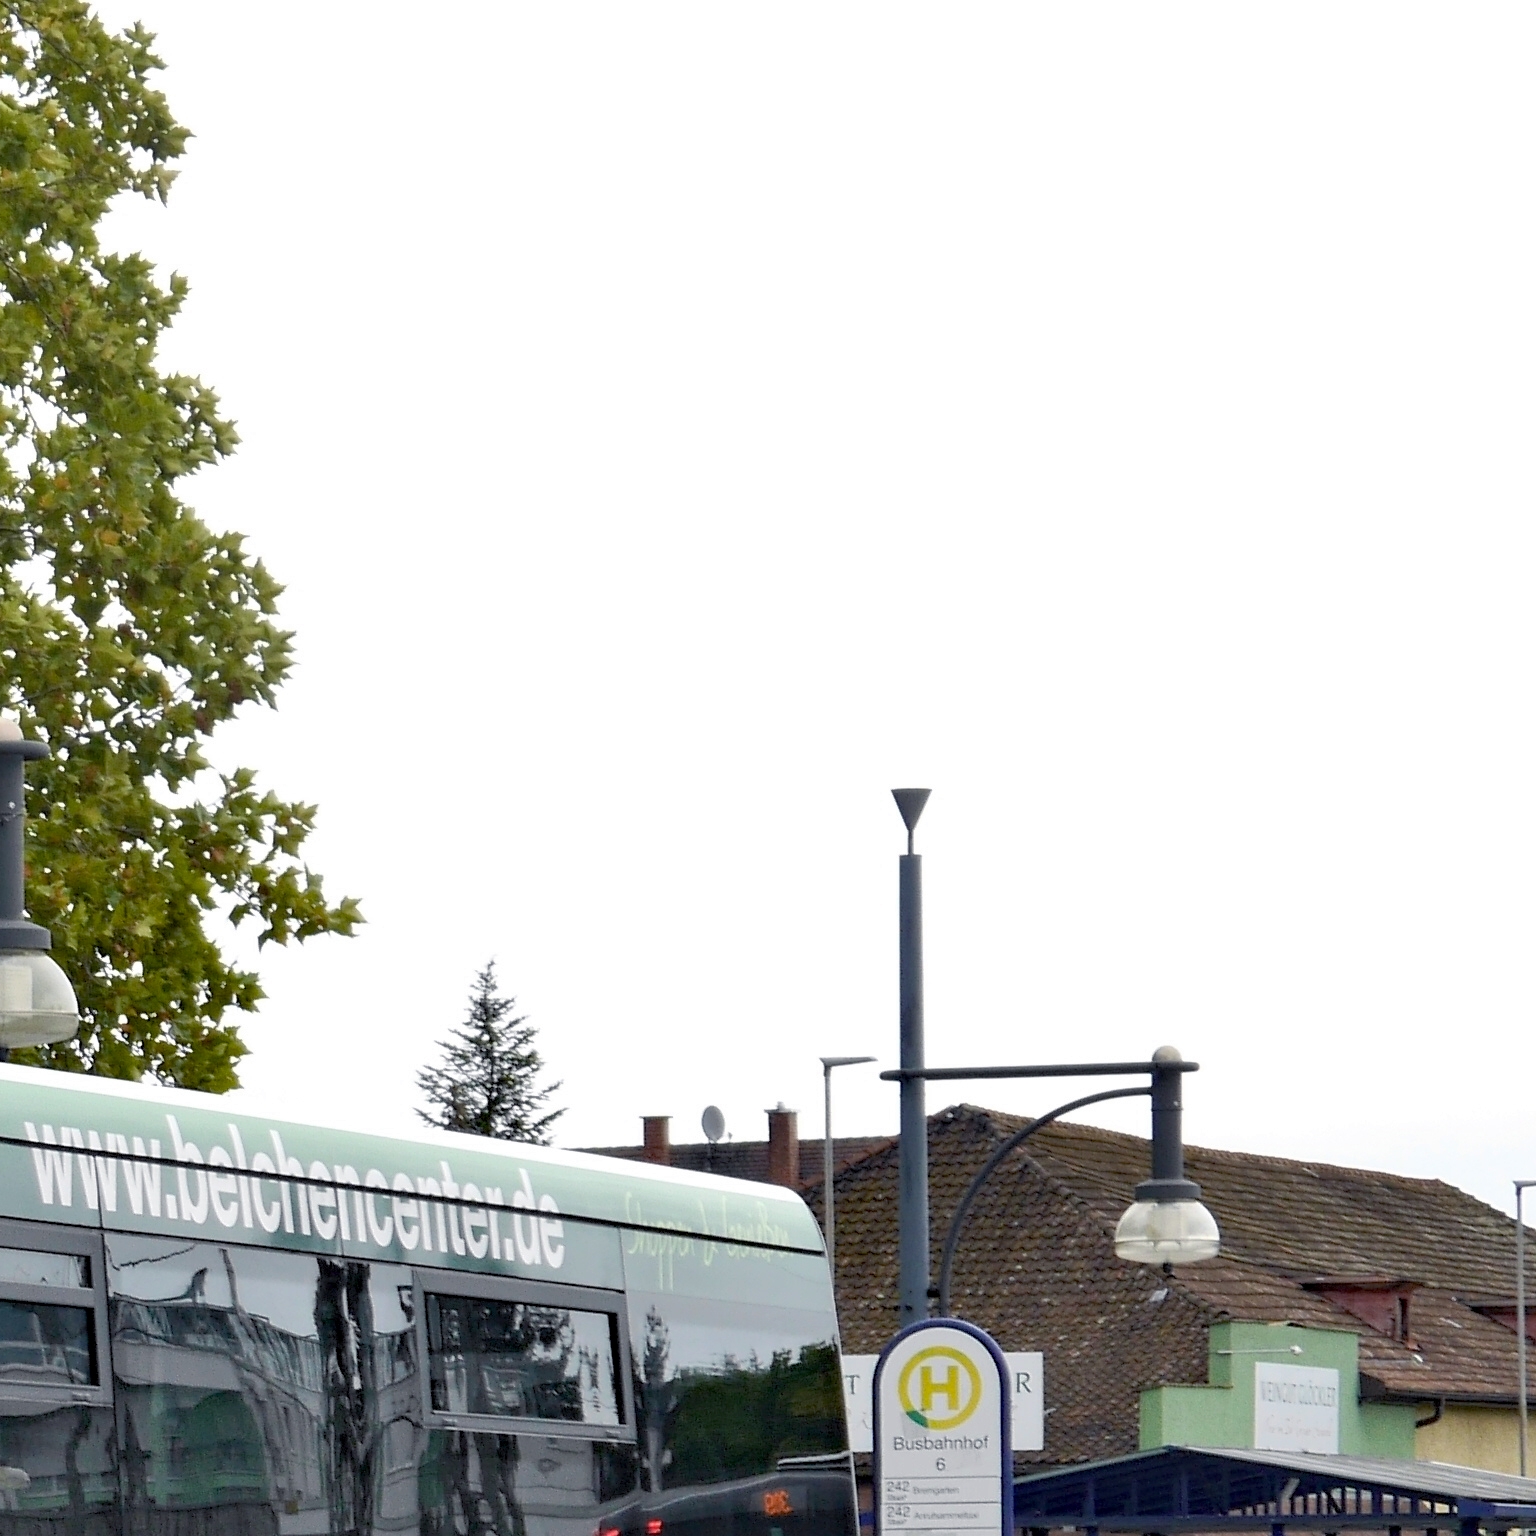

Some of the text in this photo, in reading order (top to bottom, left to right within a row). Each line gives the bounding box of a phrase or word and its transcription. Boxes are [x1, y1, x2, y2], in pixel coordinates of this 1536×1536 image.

[24, 1113, 566, 1269] www.belchencenter.de
[920, 1365, 960, 1412] H
[893, 1436, 989, 1451] Busbahnhof
[935, 1457, 946, 1472] 6
[885, 1481, 911, 1494] 242
[885, 1506, 911, 1518] 242
